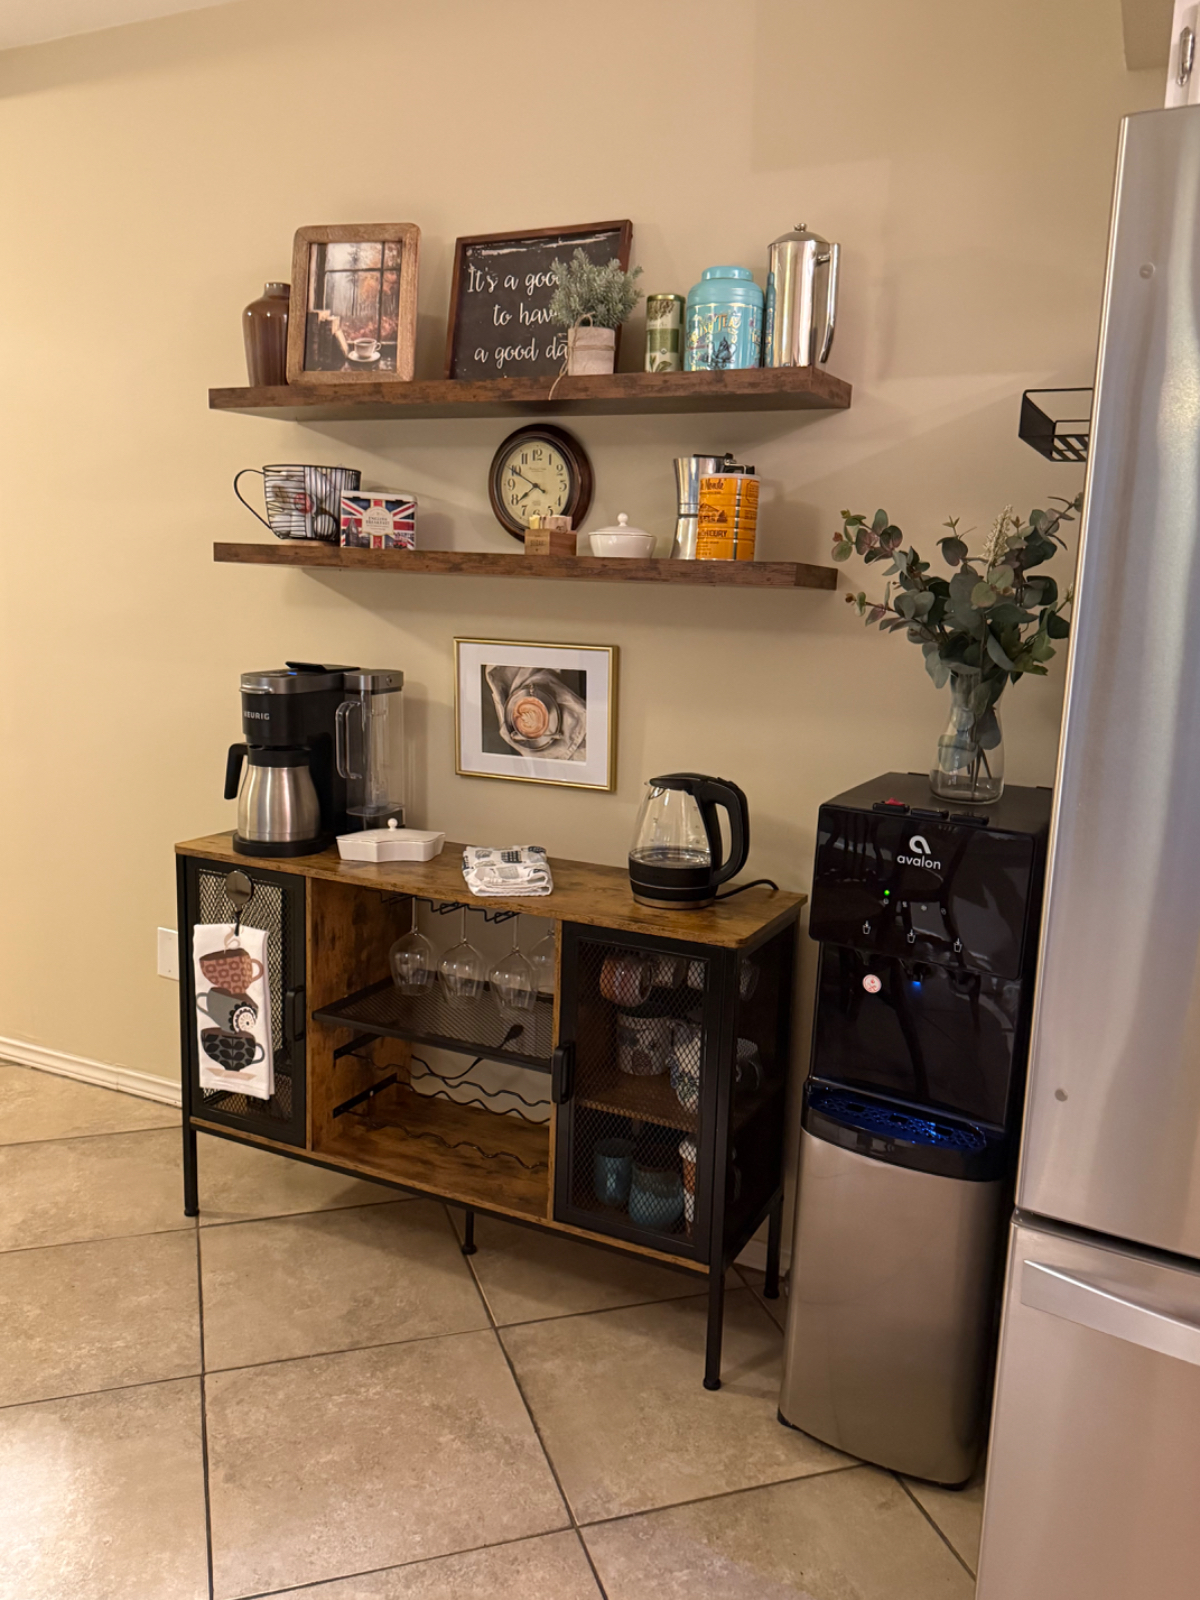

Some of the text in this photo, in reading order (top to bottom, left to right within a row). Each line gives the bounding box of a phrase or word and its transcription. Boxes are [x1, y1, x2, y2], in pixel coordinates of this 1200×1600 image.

[467, 263, 560, 296] It's a goo
[493, 302, 558, 326] to hav
[474, 336, 568, 370] a good da
[532, 449, 543, 461] 12
[556, 464, 565, 476] 2
[507, 479, 516, 492] 9
[511, 494, 519, 506] 8
[521, 505, 528, 516] 7
[896, 855, 941, 870] avalon
